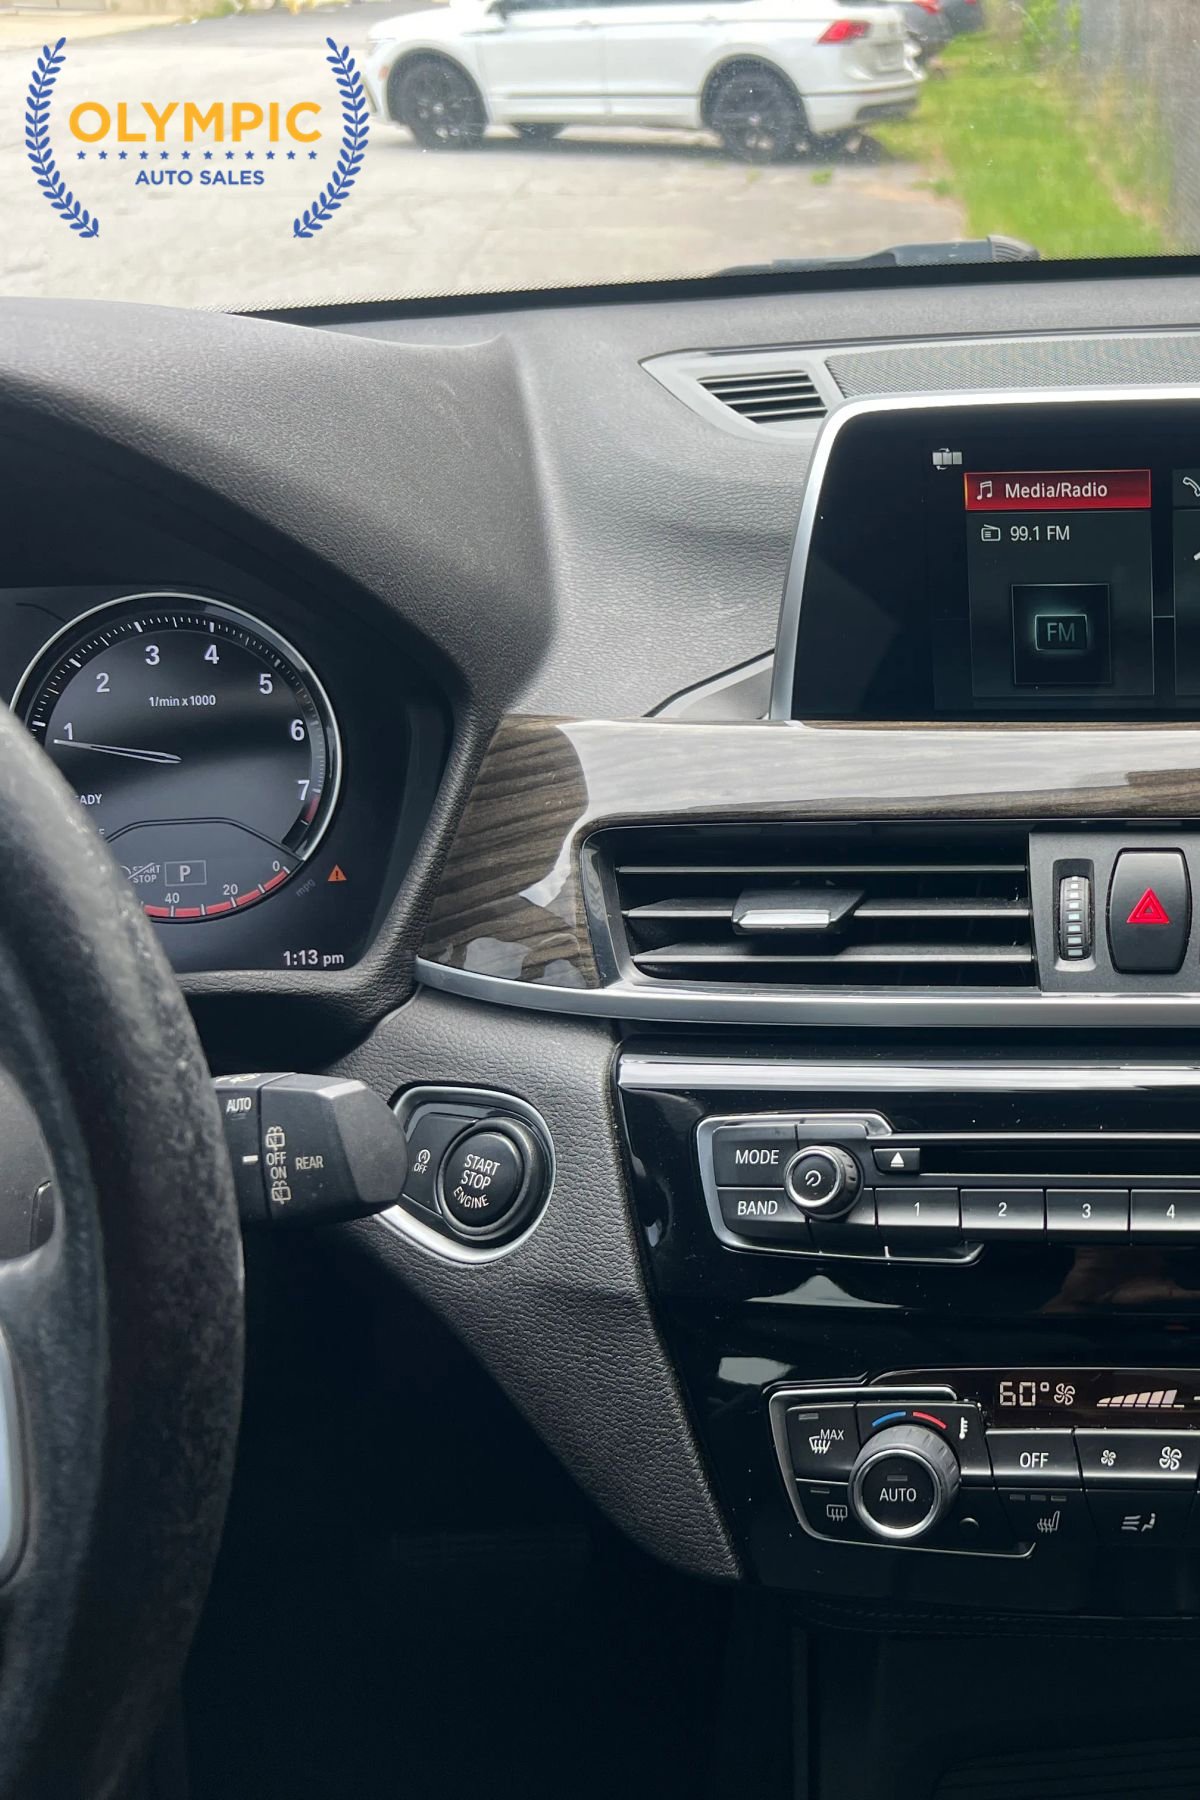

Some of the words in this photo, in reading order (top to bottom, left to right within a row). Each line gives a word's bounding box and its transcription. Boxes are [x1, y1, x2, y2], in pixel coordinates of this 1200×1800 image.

[1005, 480, 1108, 499] Media/Radio
[1010, 526, 1041, 541] 99.1
[1047, 525, 1071, 541] FM
[1047, 623, 1076, 642] FM
[145, 644, 160, 666] 3
[204, 644, 220, 665] 4
[96, 672, 110, 693] 2
[259, 673, 273, 694] 5
[148, 696, 180, 707] 1/min
[189, 694, 216, 706] 1000
[64, 722, 73, 741] 1
[290, 720, 305, 741] 6
[298, 780, 310, 801] 7
[76, 794, 102, 805] ADY
[180, 865, 191, 882] P
[272, 861, 280, 872] 0
[223, 884, 238, 896] 20
[296, 879, 316, 897] mpg
[165, 892, 180, 904] 40
[283, 949, 318, 966] 1:13
[323, 954, 344, 966] pm
[226, 1097, 252, 1112] AUTO
[266, 1152, 286, 1165] OFF
[295, 1156, 324, 1170] REAR
[464, 1154, 500, 1176] START
[735, 1149, 780, 1166] MODE
[270, 1166, 287, 1179] ON
[413, 1163, 428, 1174] OFF
[461, 1170, 491, 1190] STOP
[453, 1186, 490, 1209] ENGINE
[736, 1200, 778, 1217] BAND
[912, 1203, 920, 1217] 1
[998, 1203, 1007, 1217] 2
[1082, 1204, 1091, 1218] 3
[1166, 1204, 1176, 1220] 4
[820, 1430, 844, 1441] MAX
[1020, 1452, 1049, 1468] OFF
[879, 1488, 917, 1503] AUTO
